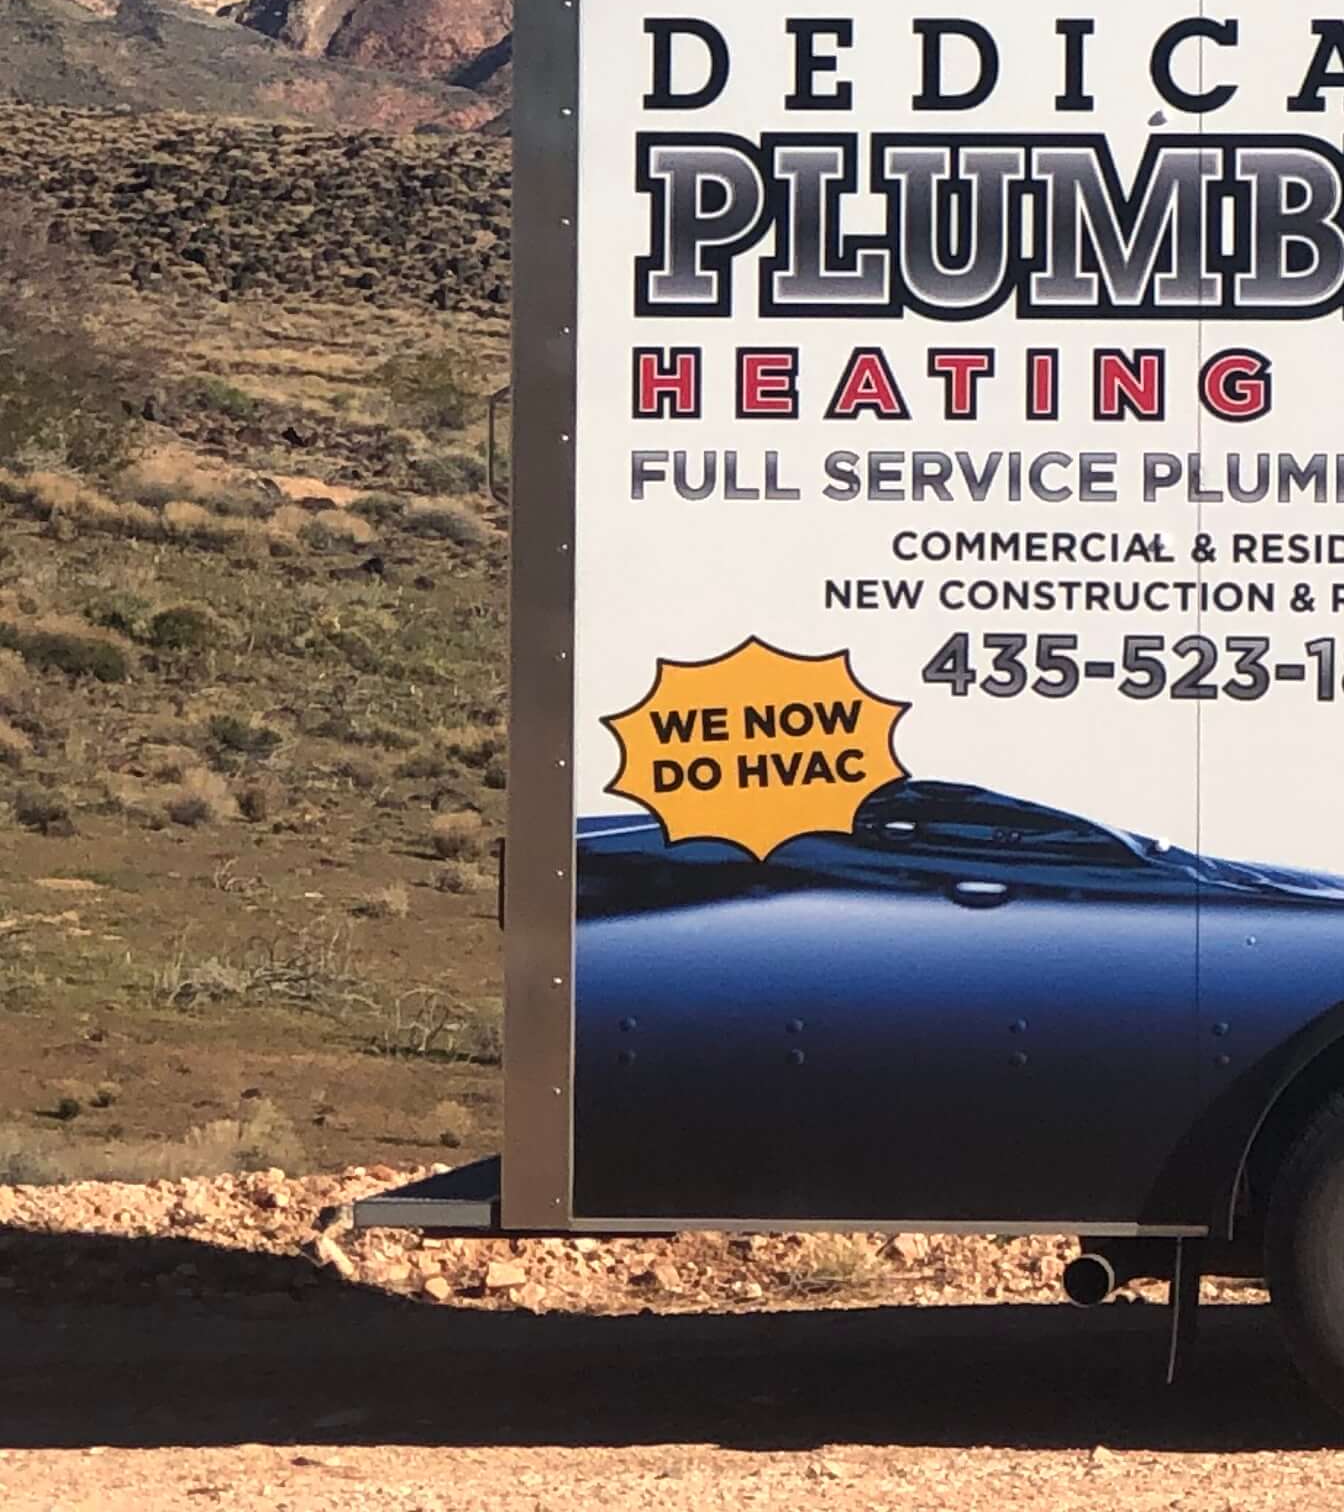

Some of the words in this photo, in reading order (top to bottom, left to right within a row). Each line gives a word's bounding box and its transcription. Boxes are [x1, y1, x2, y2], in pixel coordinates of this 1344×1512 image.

[631, 346, 1272, 422] HEATING
[630, 450, 801, 501] FULL
[822, 450, 1118, 503] SERVICE
[892, 531, 1174, 563] COMMERCIAL
[1190, 533, 1218, 563] &
[824, 579, 925, 610] NEW
[938, 580, 1275, 613] CONSTRUCTION
[1289, 583, 1316, 614] &
[649, 707, 730, 745] WE
[744, 699, 863, 740] NOW
[653, 756, 723, 793] DO
[737, 748, 867, 789] HVAC
